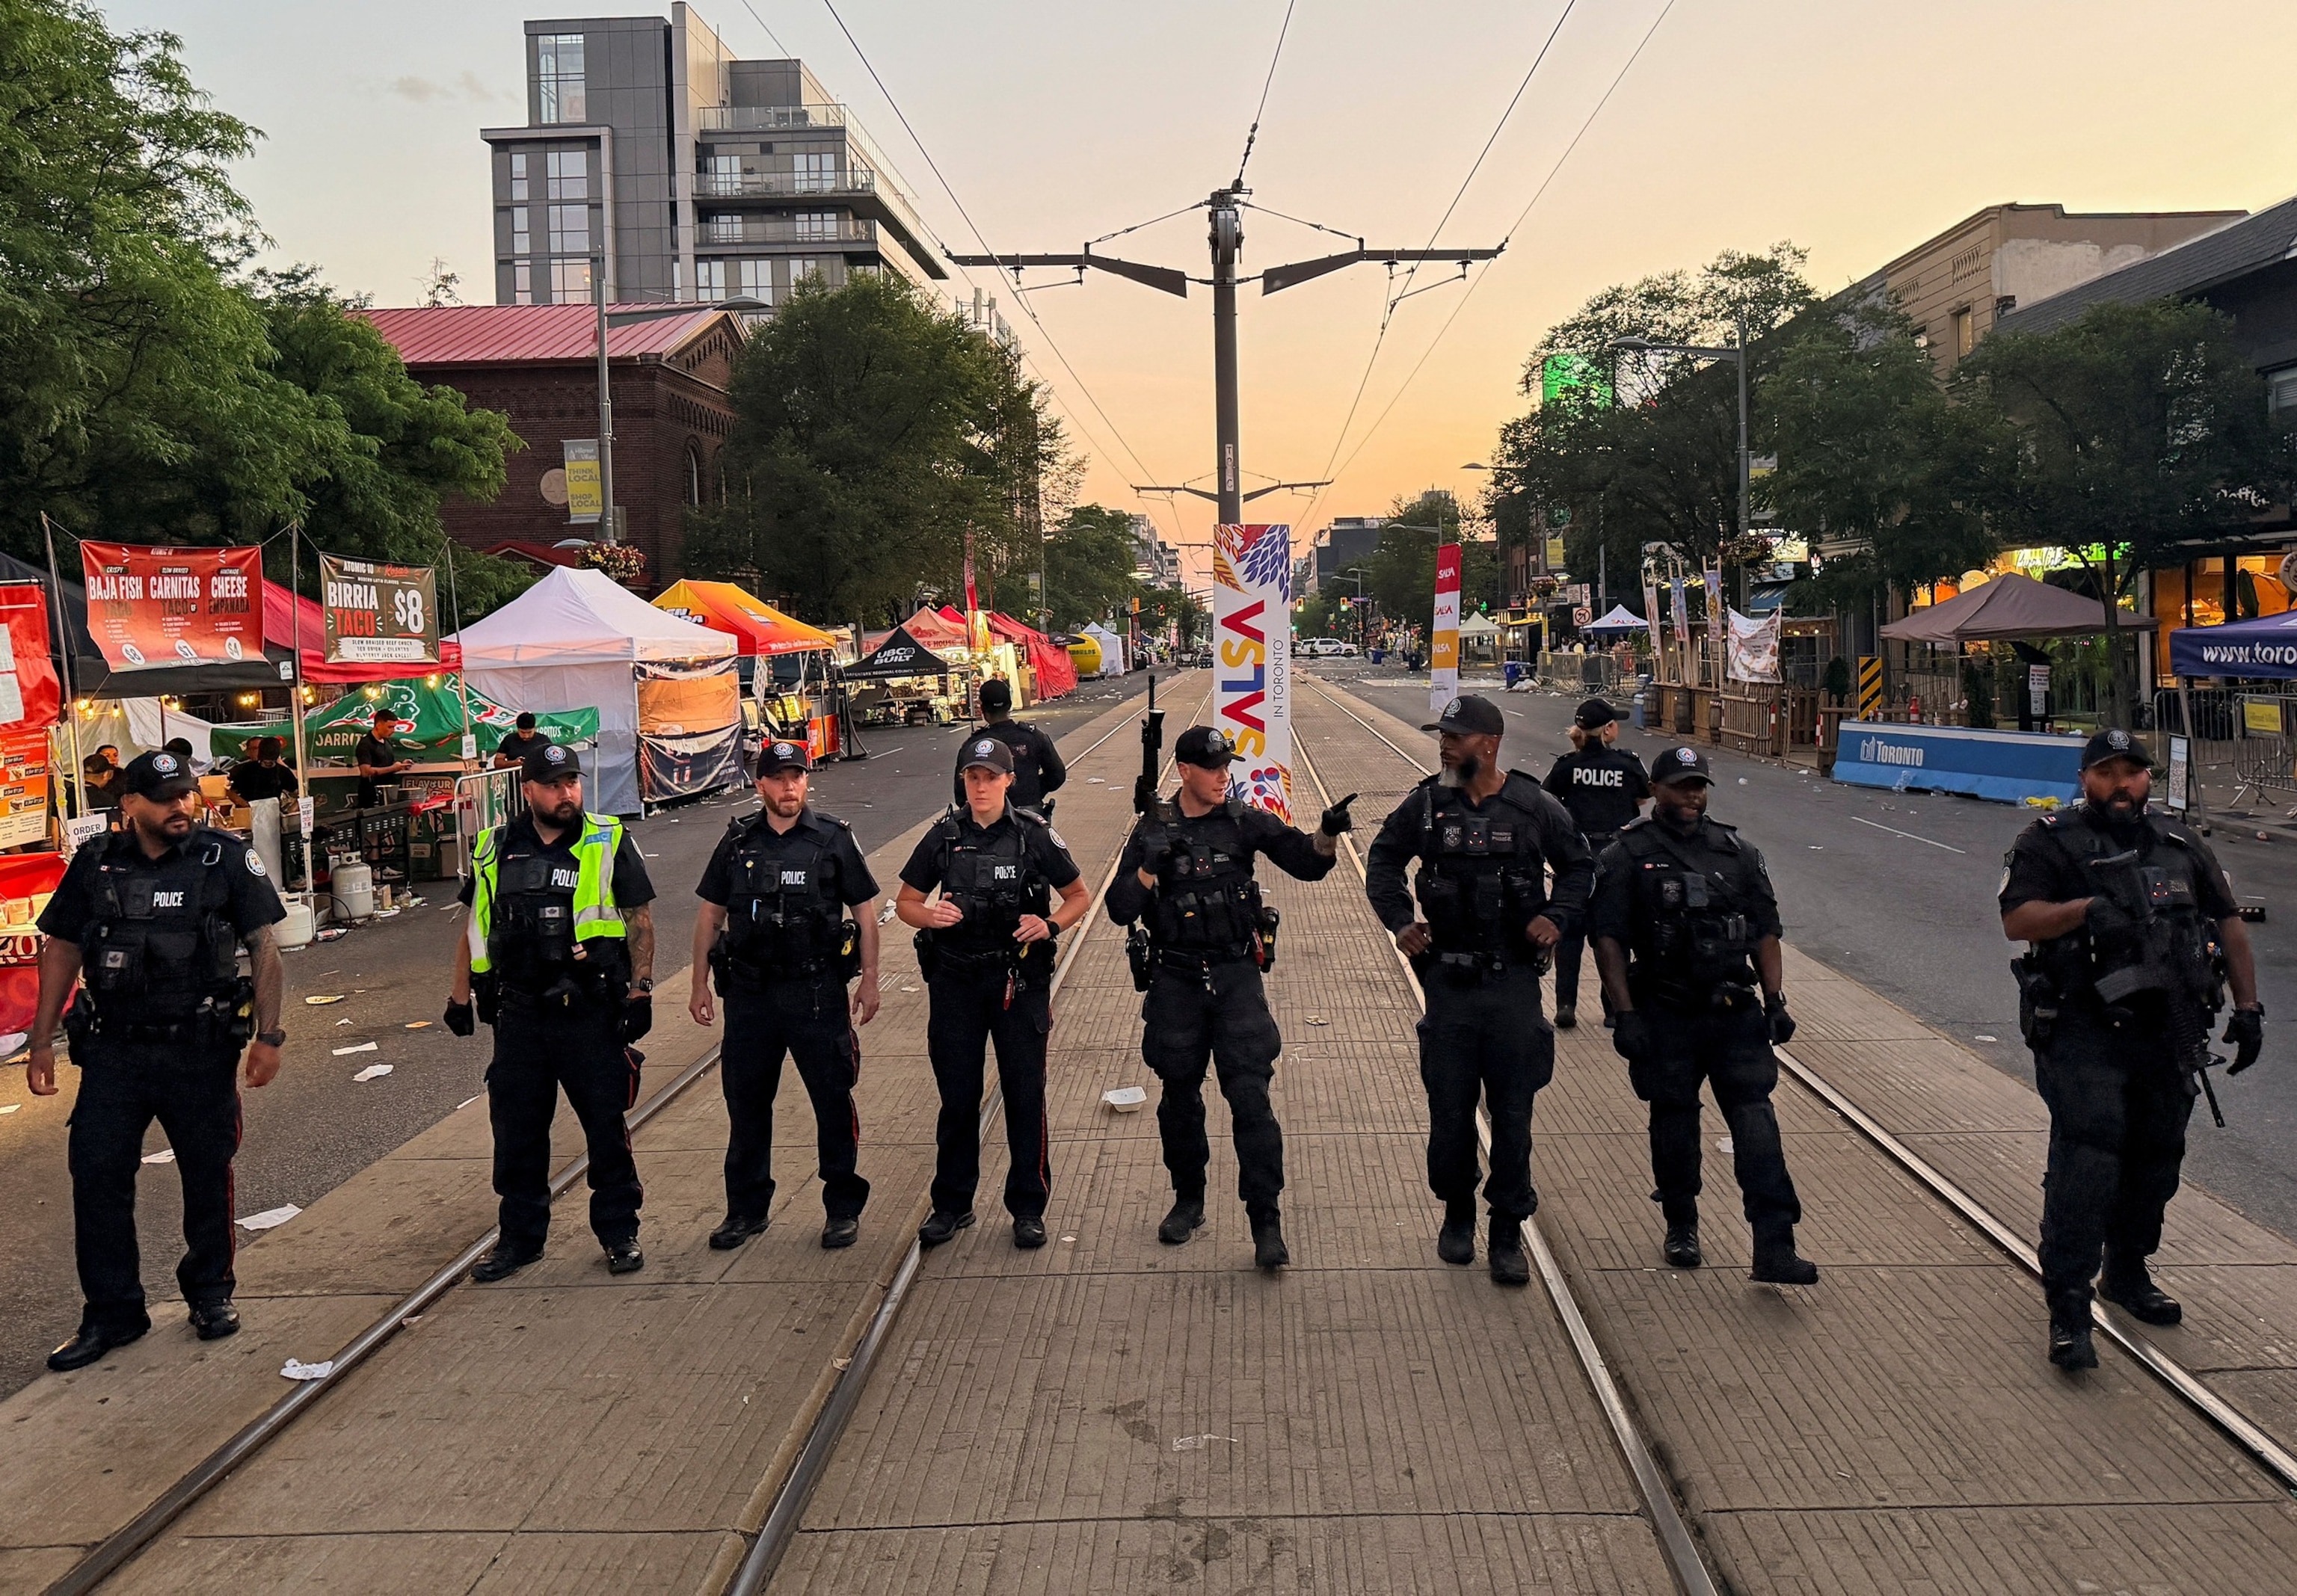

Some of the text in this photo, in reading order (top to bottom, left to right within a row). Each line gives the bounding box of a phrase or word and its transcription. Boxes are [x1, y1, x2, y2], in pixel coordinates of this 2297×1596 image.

[343, 560, 366, 573] ATOMIC
[367, 564, 374, 574] 10
[1438, 567, 1456, 579] SALSA
[88, 576, 143, 600] BAJA FISH
[150, 576, 200, 599] CARNITAS
[211, 576, 248, 598] CHEESE
[327, 581, 378, 610] BIRRIA
[161, 599, 188, 615] TACO
[209, 599, 250, 614] EMPANADA
[394, 588, 425, 634] $8
[1434, 605, 1453, 616] SALSA
[333, 609, 375, 636] TACO
[229, 643, 240, 656] $4
[932, 639, 956, 647] HOUSE
[1432, 642, 1451, 653] SALSA
[125, 648, 141, 661] $8
[873, 655, 914, 665] BUILT
[1220, 600, 1265, 758] SALSA
[1273, 639, 1284, 718] IN TORONTO
[1876, 741, 1924, 766] TORONTO
[1572, 768, 1623, 787] POLICE
[73, 824, 101, 835] ORDER
[781, 870, 806, 885] POLICE
[153, 891, 184, 908] POLICE
